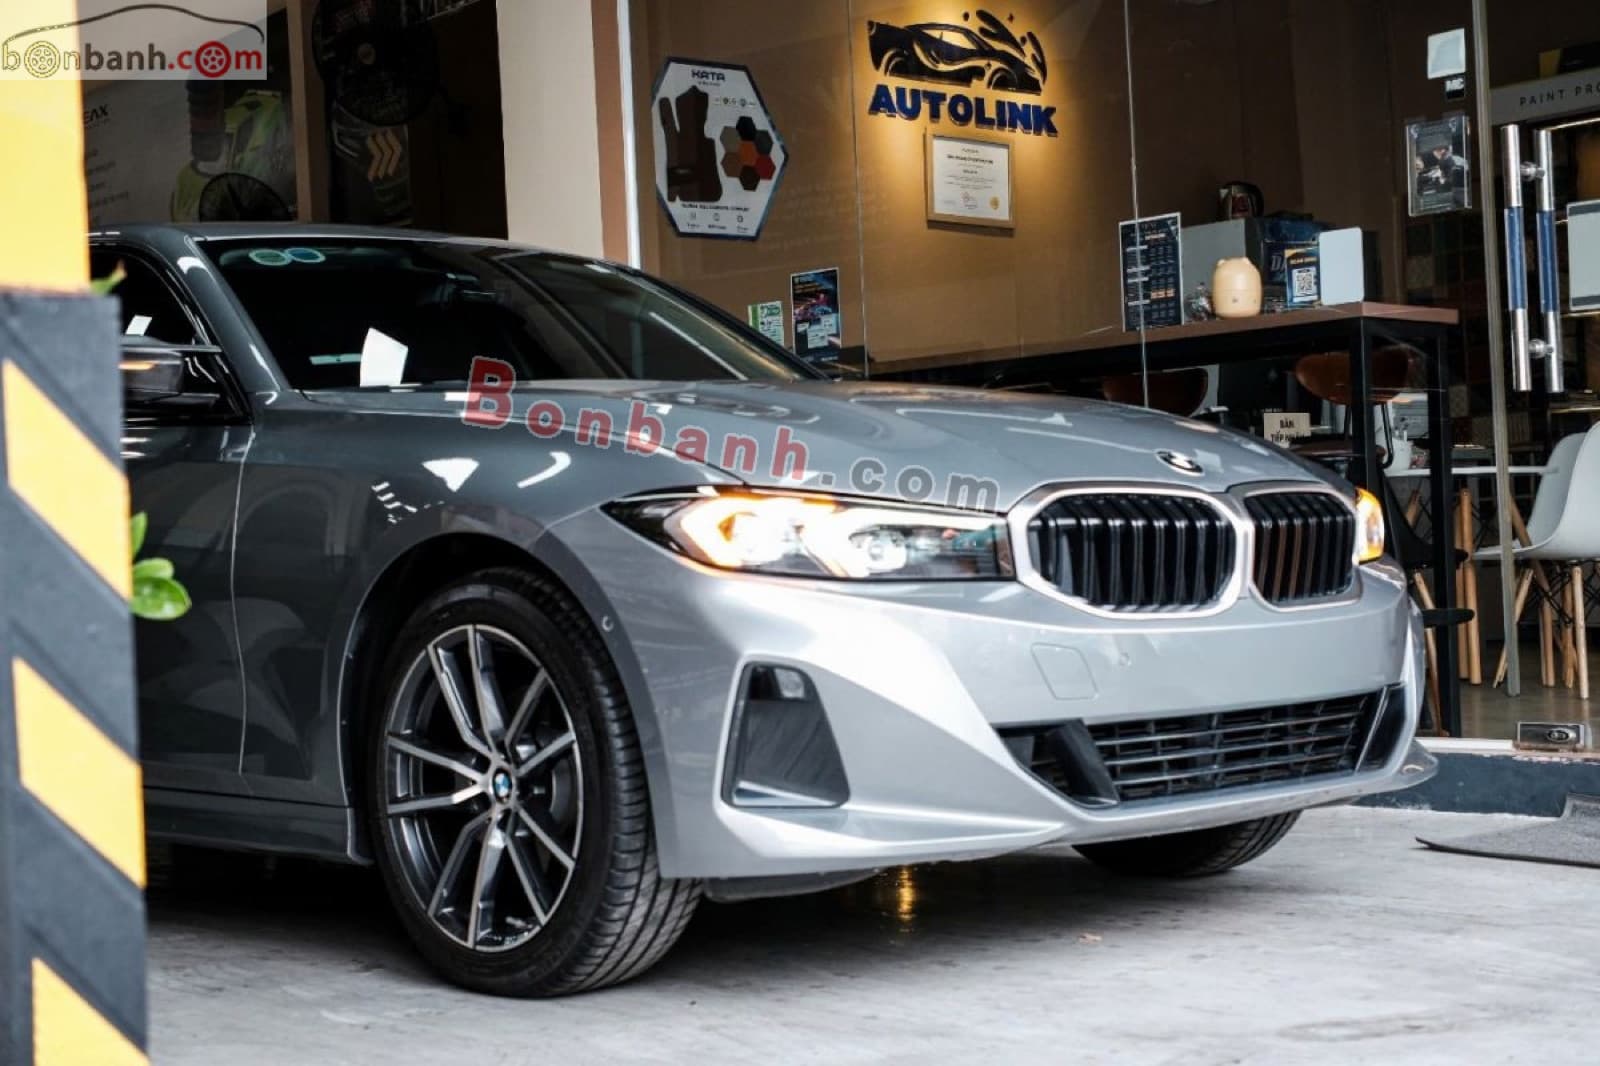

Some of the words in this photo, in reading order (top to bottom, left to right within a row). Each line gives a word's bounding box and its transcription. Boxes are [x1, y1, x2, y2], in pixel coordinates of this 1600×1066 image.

[690, 69, 726, 82] KATA
[1520, 90, 1565, 106] PAINT
[868, 83, 1058, 137] AUTOLINK
